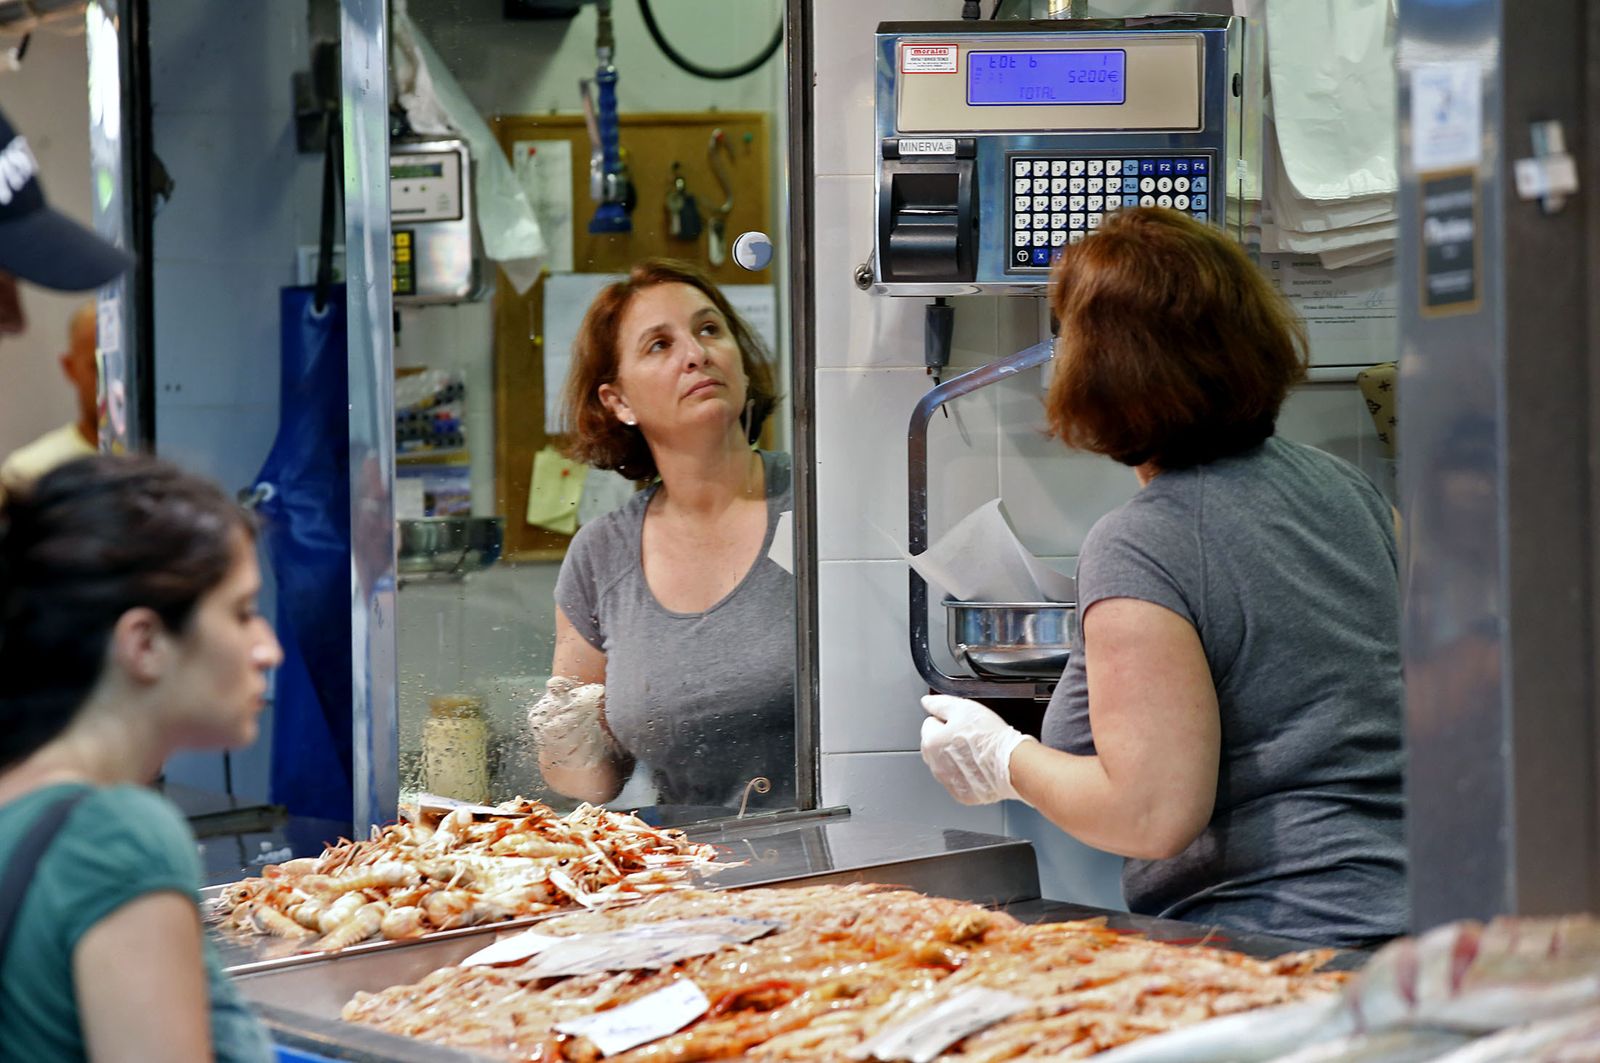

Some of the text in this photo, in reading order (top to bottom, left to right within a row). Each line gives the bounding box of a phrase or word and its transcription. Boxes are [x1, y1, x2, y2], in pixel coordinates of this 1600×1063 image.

[1019, 86, 1057, 100] TOTAL
[900, 141, 945, 152] MINERVA
[1143, 164, 1153, 172] F1
[1177, 163, 1188, 171] F3
[1194, 163, 1205, 171] F4
